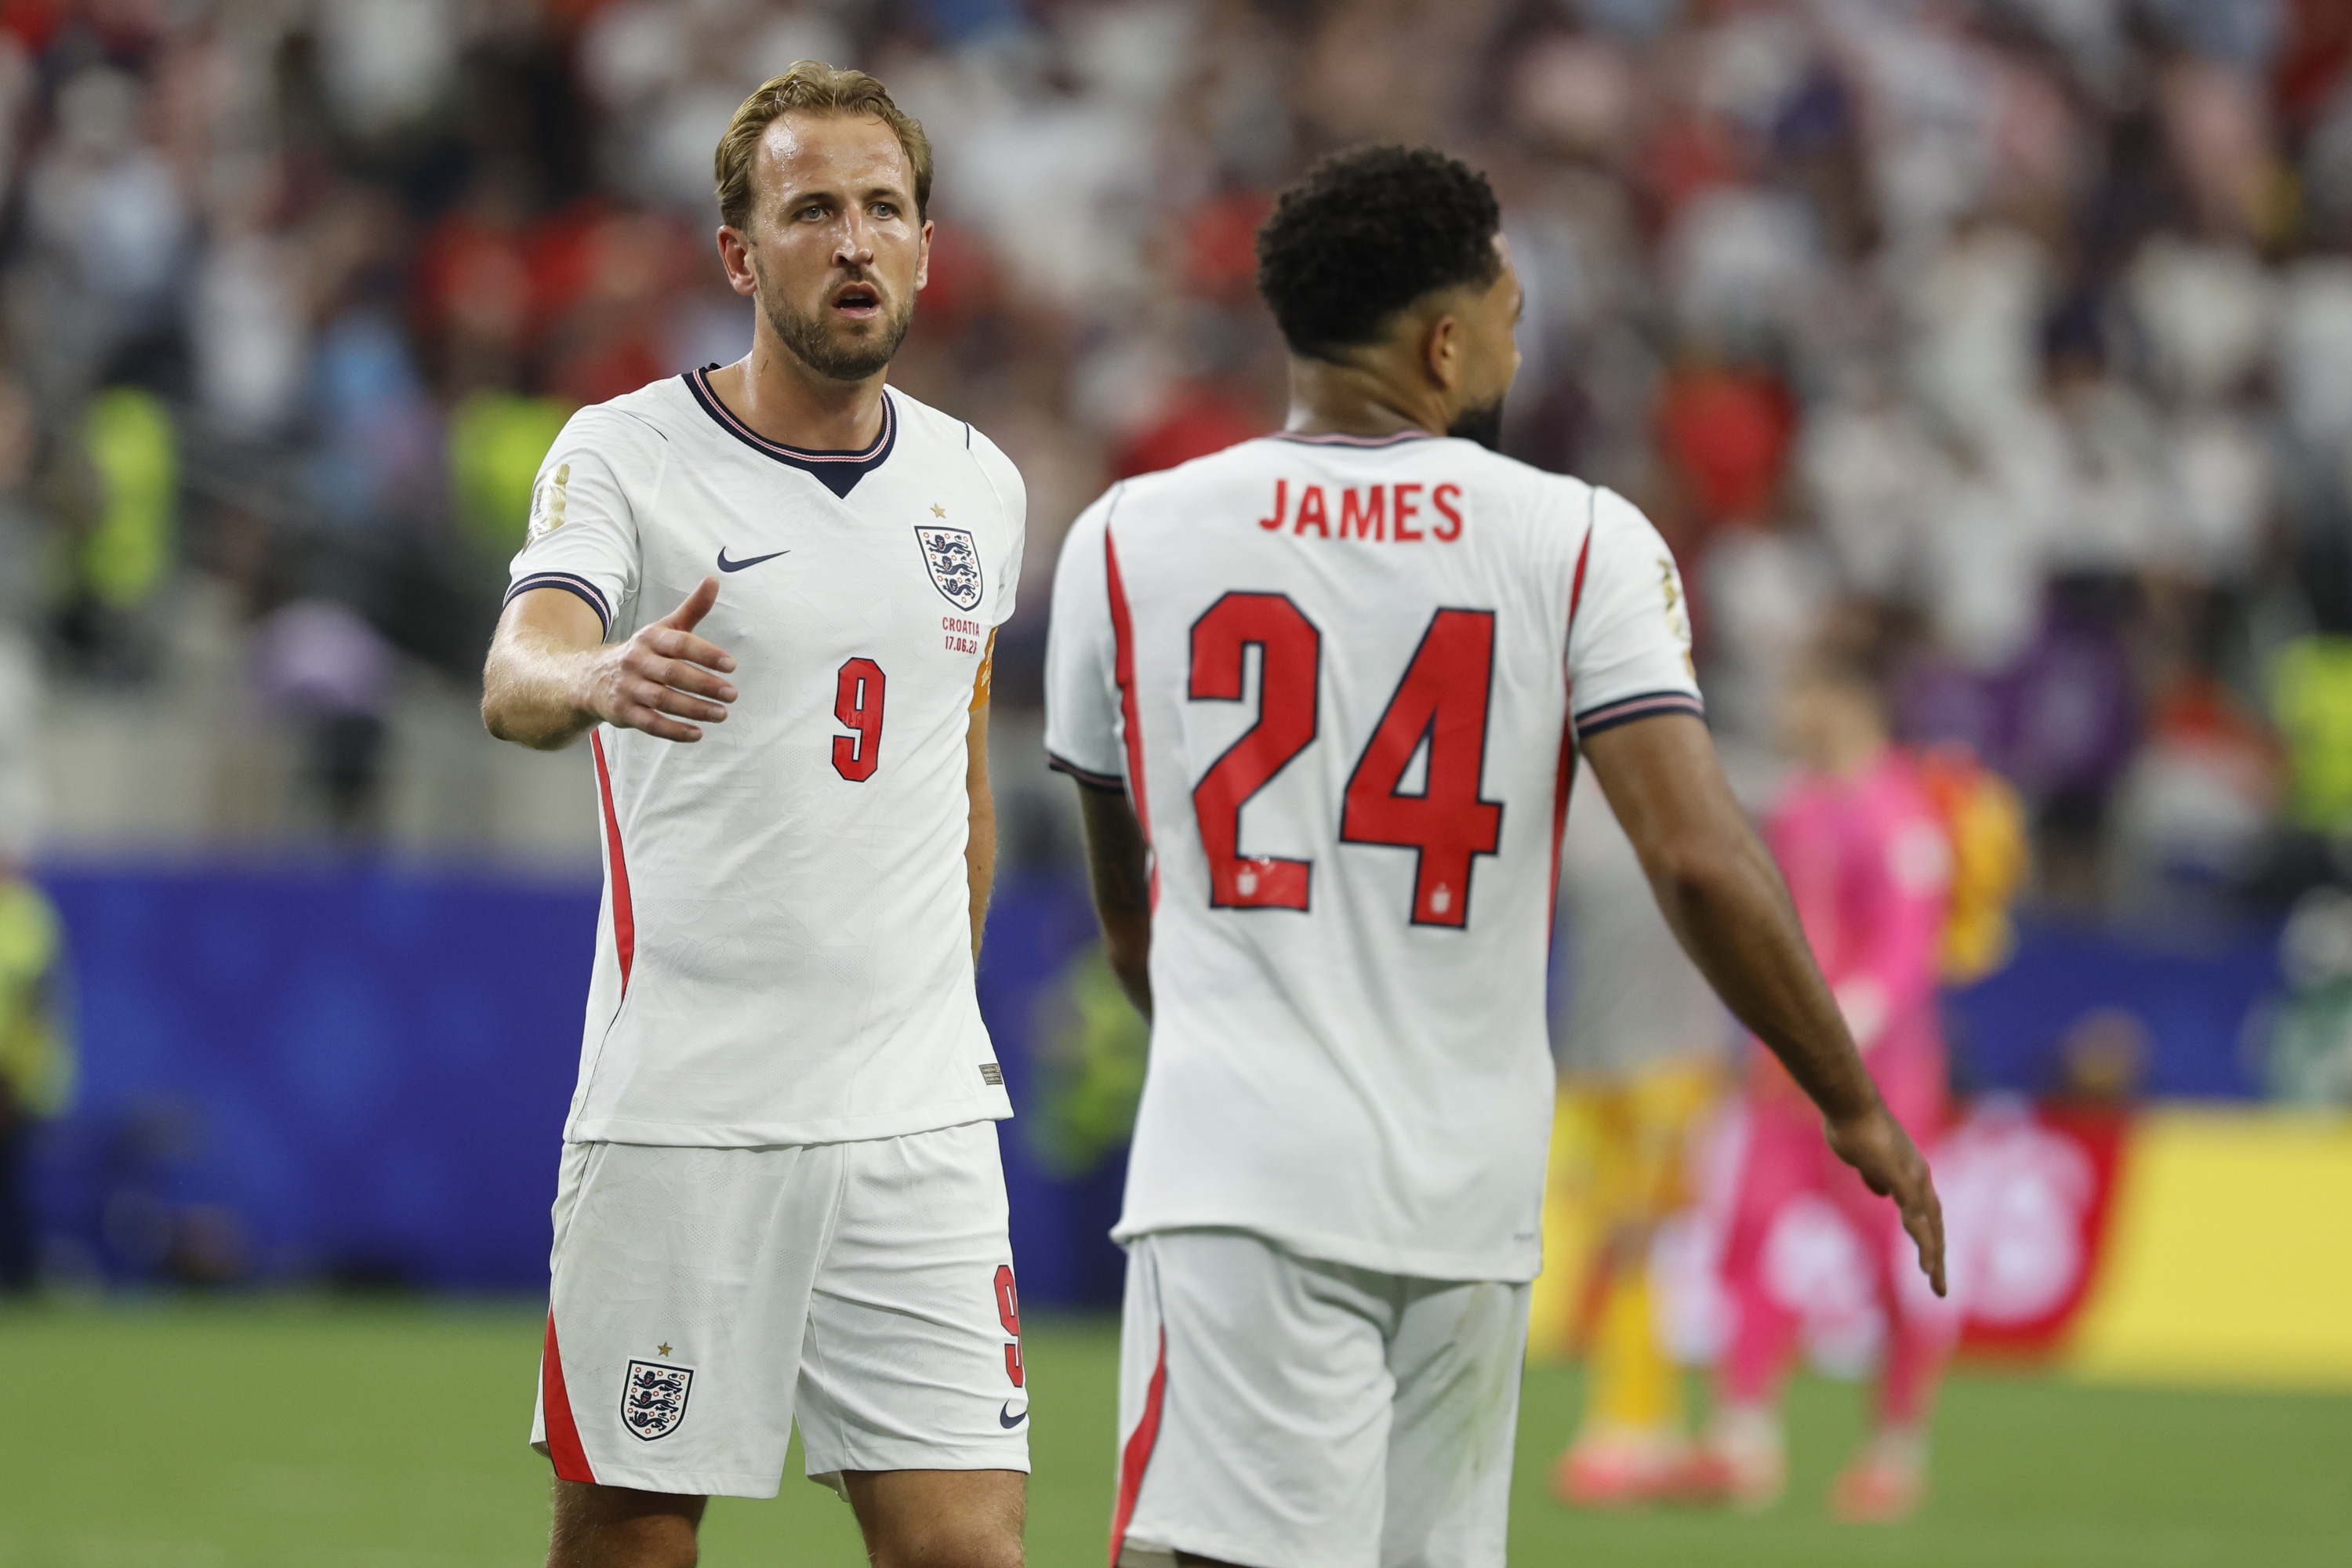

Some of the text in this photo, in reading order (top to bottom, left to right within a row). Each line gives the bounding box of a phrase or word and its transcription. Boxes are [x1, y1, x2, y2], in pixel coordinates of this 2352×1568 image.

[1258, 479, 1463, 542] JAMES
[942, 617, 979, 637] CROATIA
[832, 657, 886, 782] 9
[1189, 590, 1505, 930] 24
[993, 1265, 1023, 1388] 9
